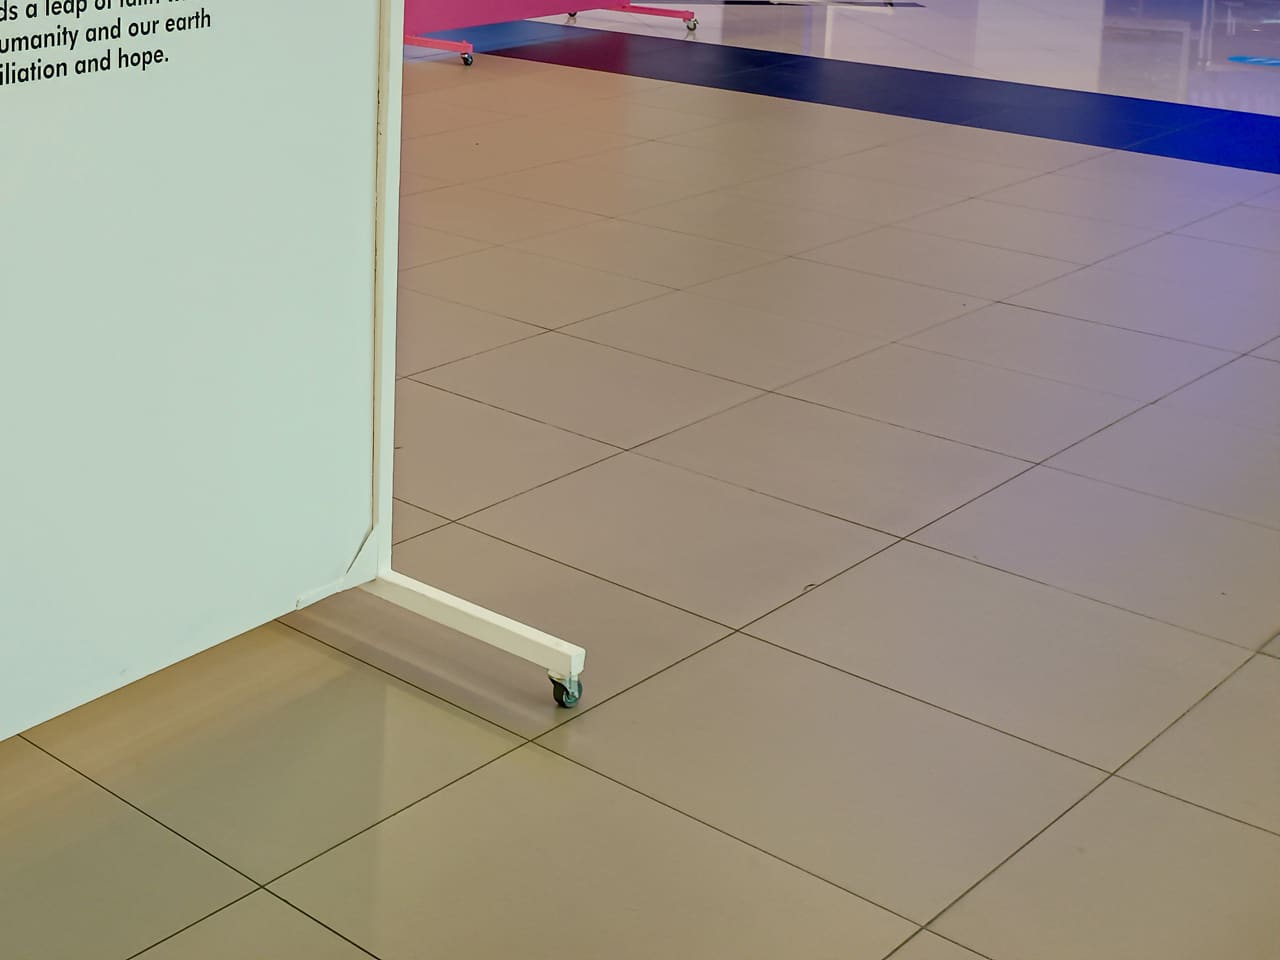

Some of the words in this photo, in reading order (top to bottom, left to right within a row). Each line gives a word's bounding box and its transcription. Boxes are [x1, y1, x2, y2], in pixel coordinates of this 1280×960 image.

[25, 3, 38, 19] a
[85, 16, 121, 43] and
[128, 19, 160, 37] our
[165, 7, 211, 33] earth
[74, 48, 111, 75] and
[118, 47, 169, 72] hope.
